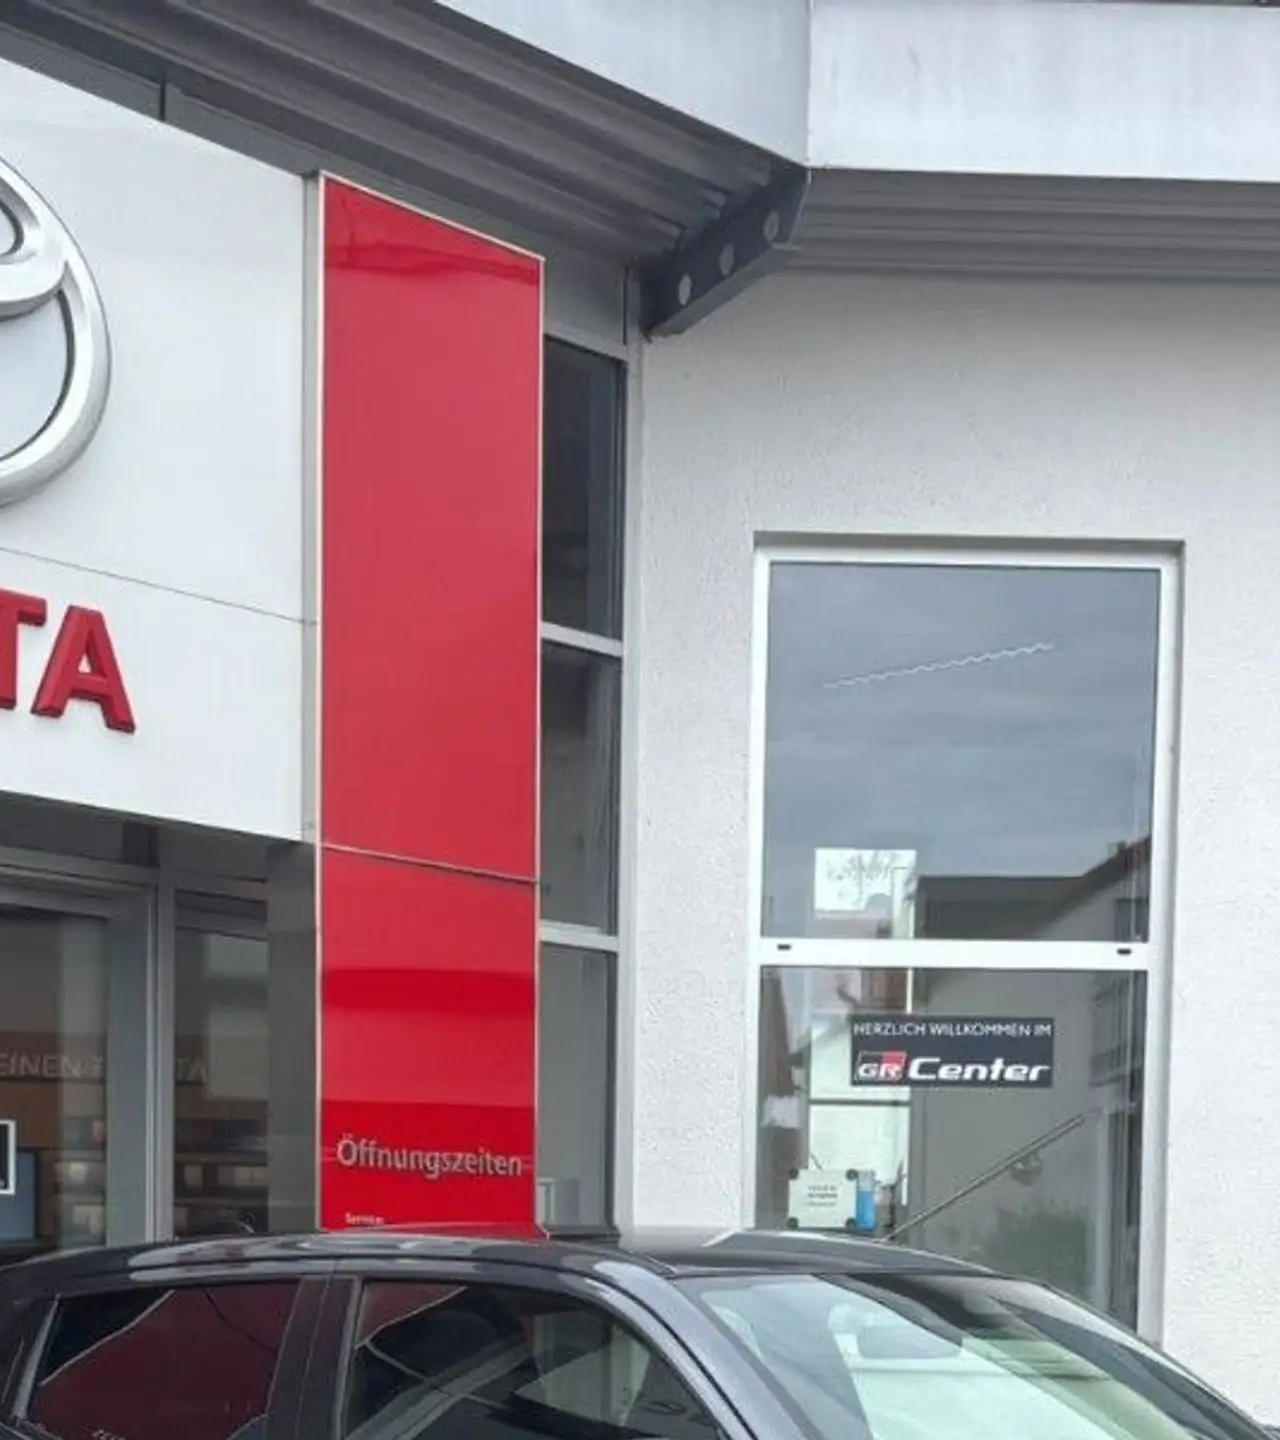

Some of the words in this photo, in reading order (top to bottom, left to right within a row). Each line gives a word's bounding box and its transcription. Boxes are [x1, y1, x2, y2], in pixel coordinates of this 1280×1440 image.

[854, 1022, 925, 1037] HERZLICH
[930, 1023, 1030, 1037] WILLKOMMEN
[1034, 1024, 1051, 1037] IM
[858, 1062, 899, 1081] GR
[909, 1057, 1050, 1081] Center
[337, 1133, 522, 1179] Öffnungszeiten
